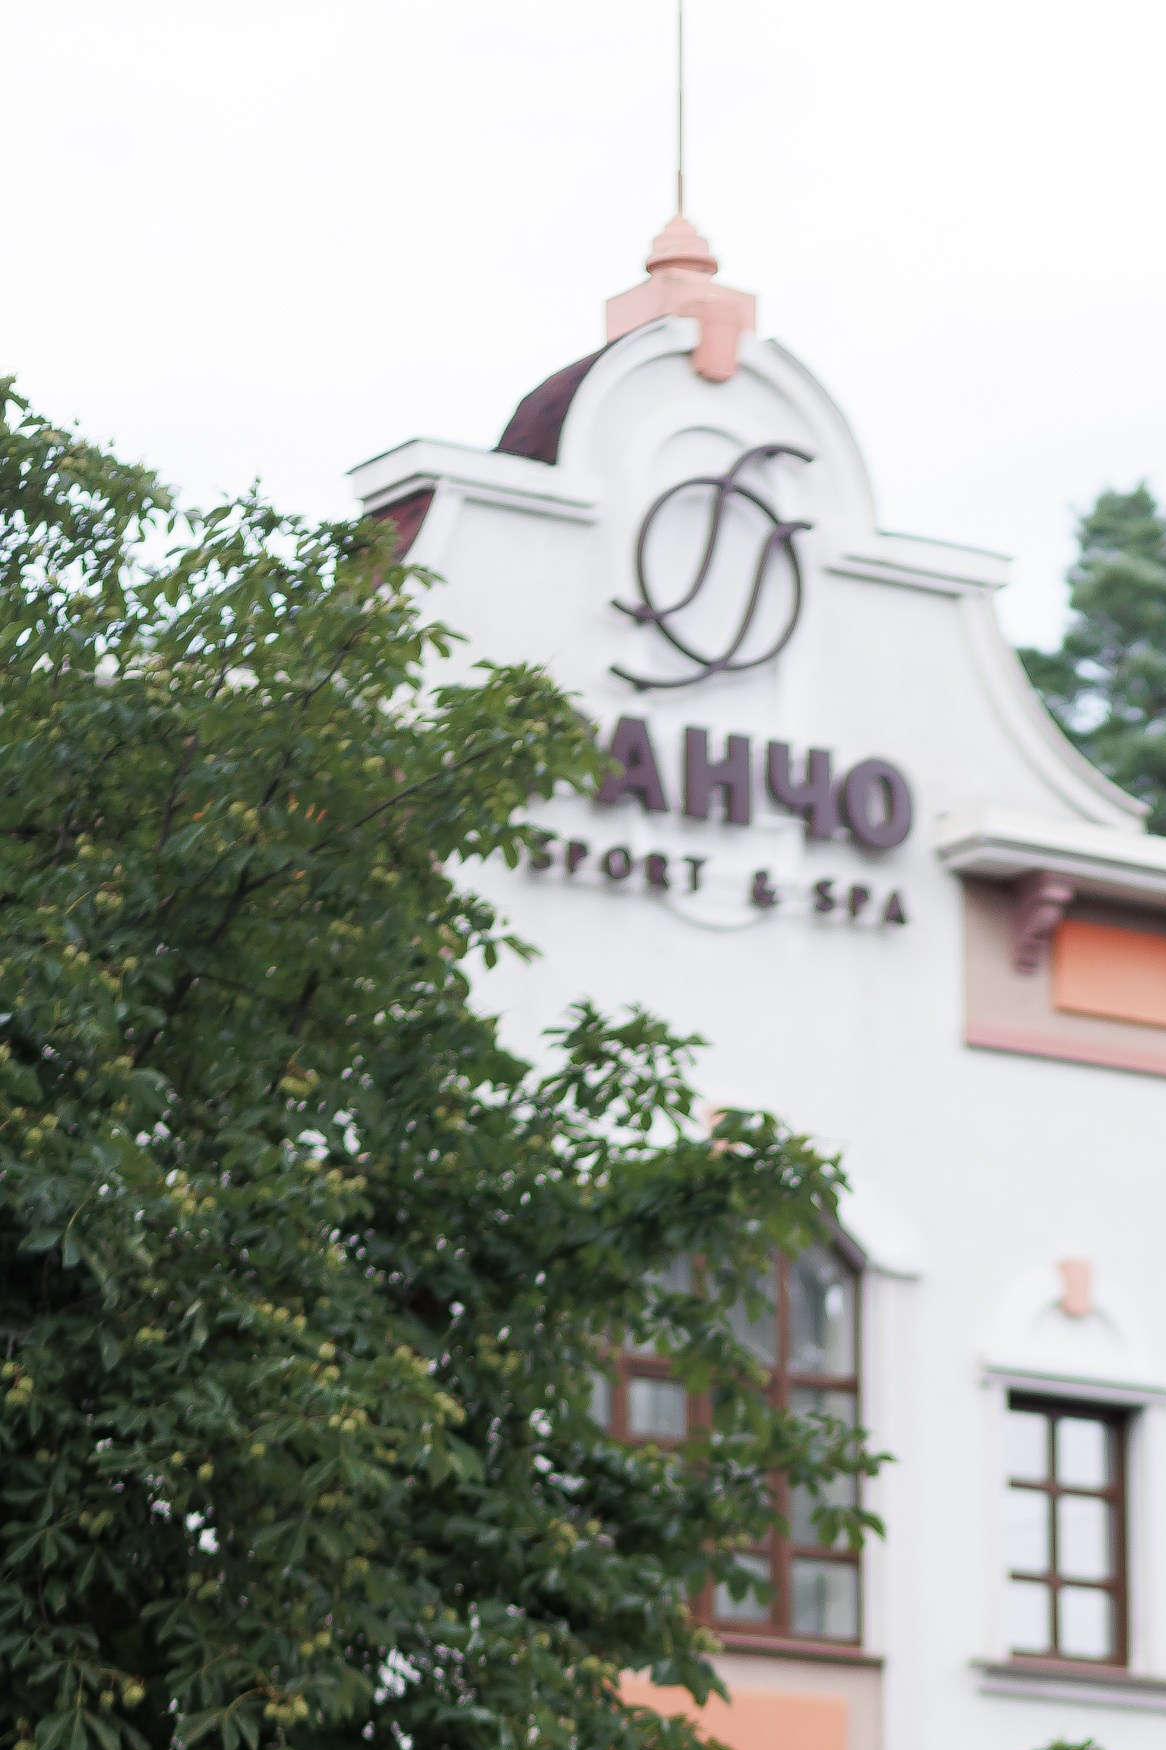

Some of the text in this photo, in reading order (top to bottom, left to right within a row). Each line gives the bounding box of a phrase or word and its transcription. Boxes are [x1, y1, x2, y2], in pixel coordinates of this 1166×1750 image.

[540, 708, 912, 852] АНЧО
[528, 830, 907, 926] SPORT & SPA
